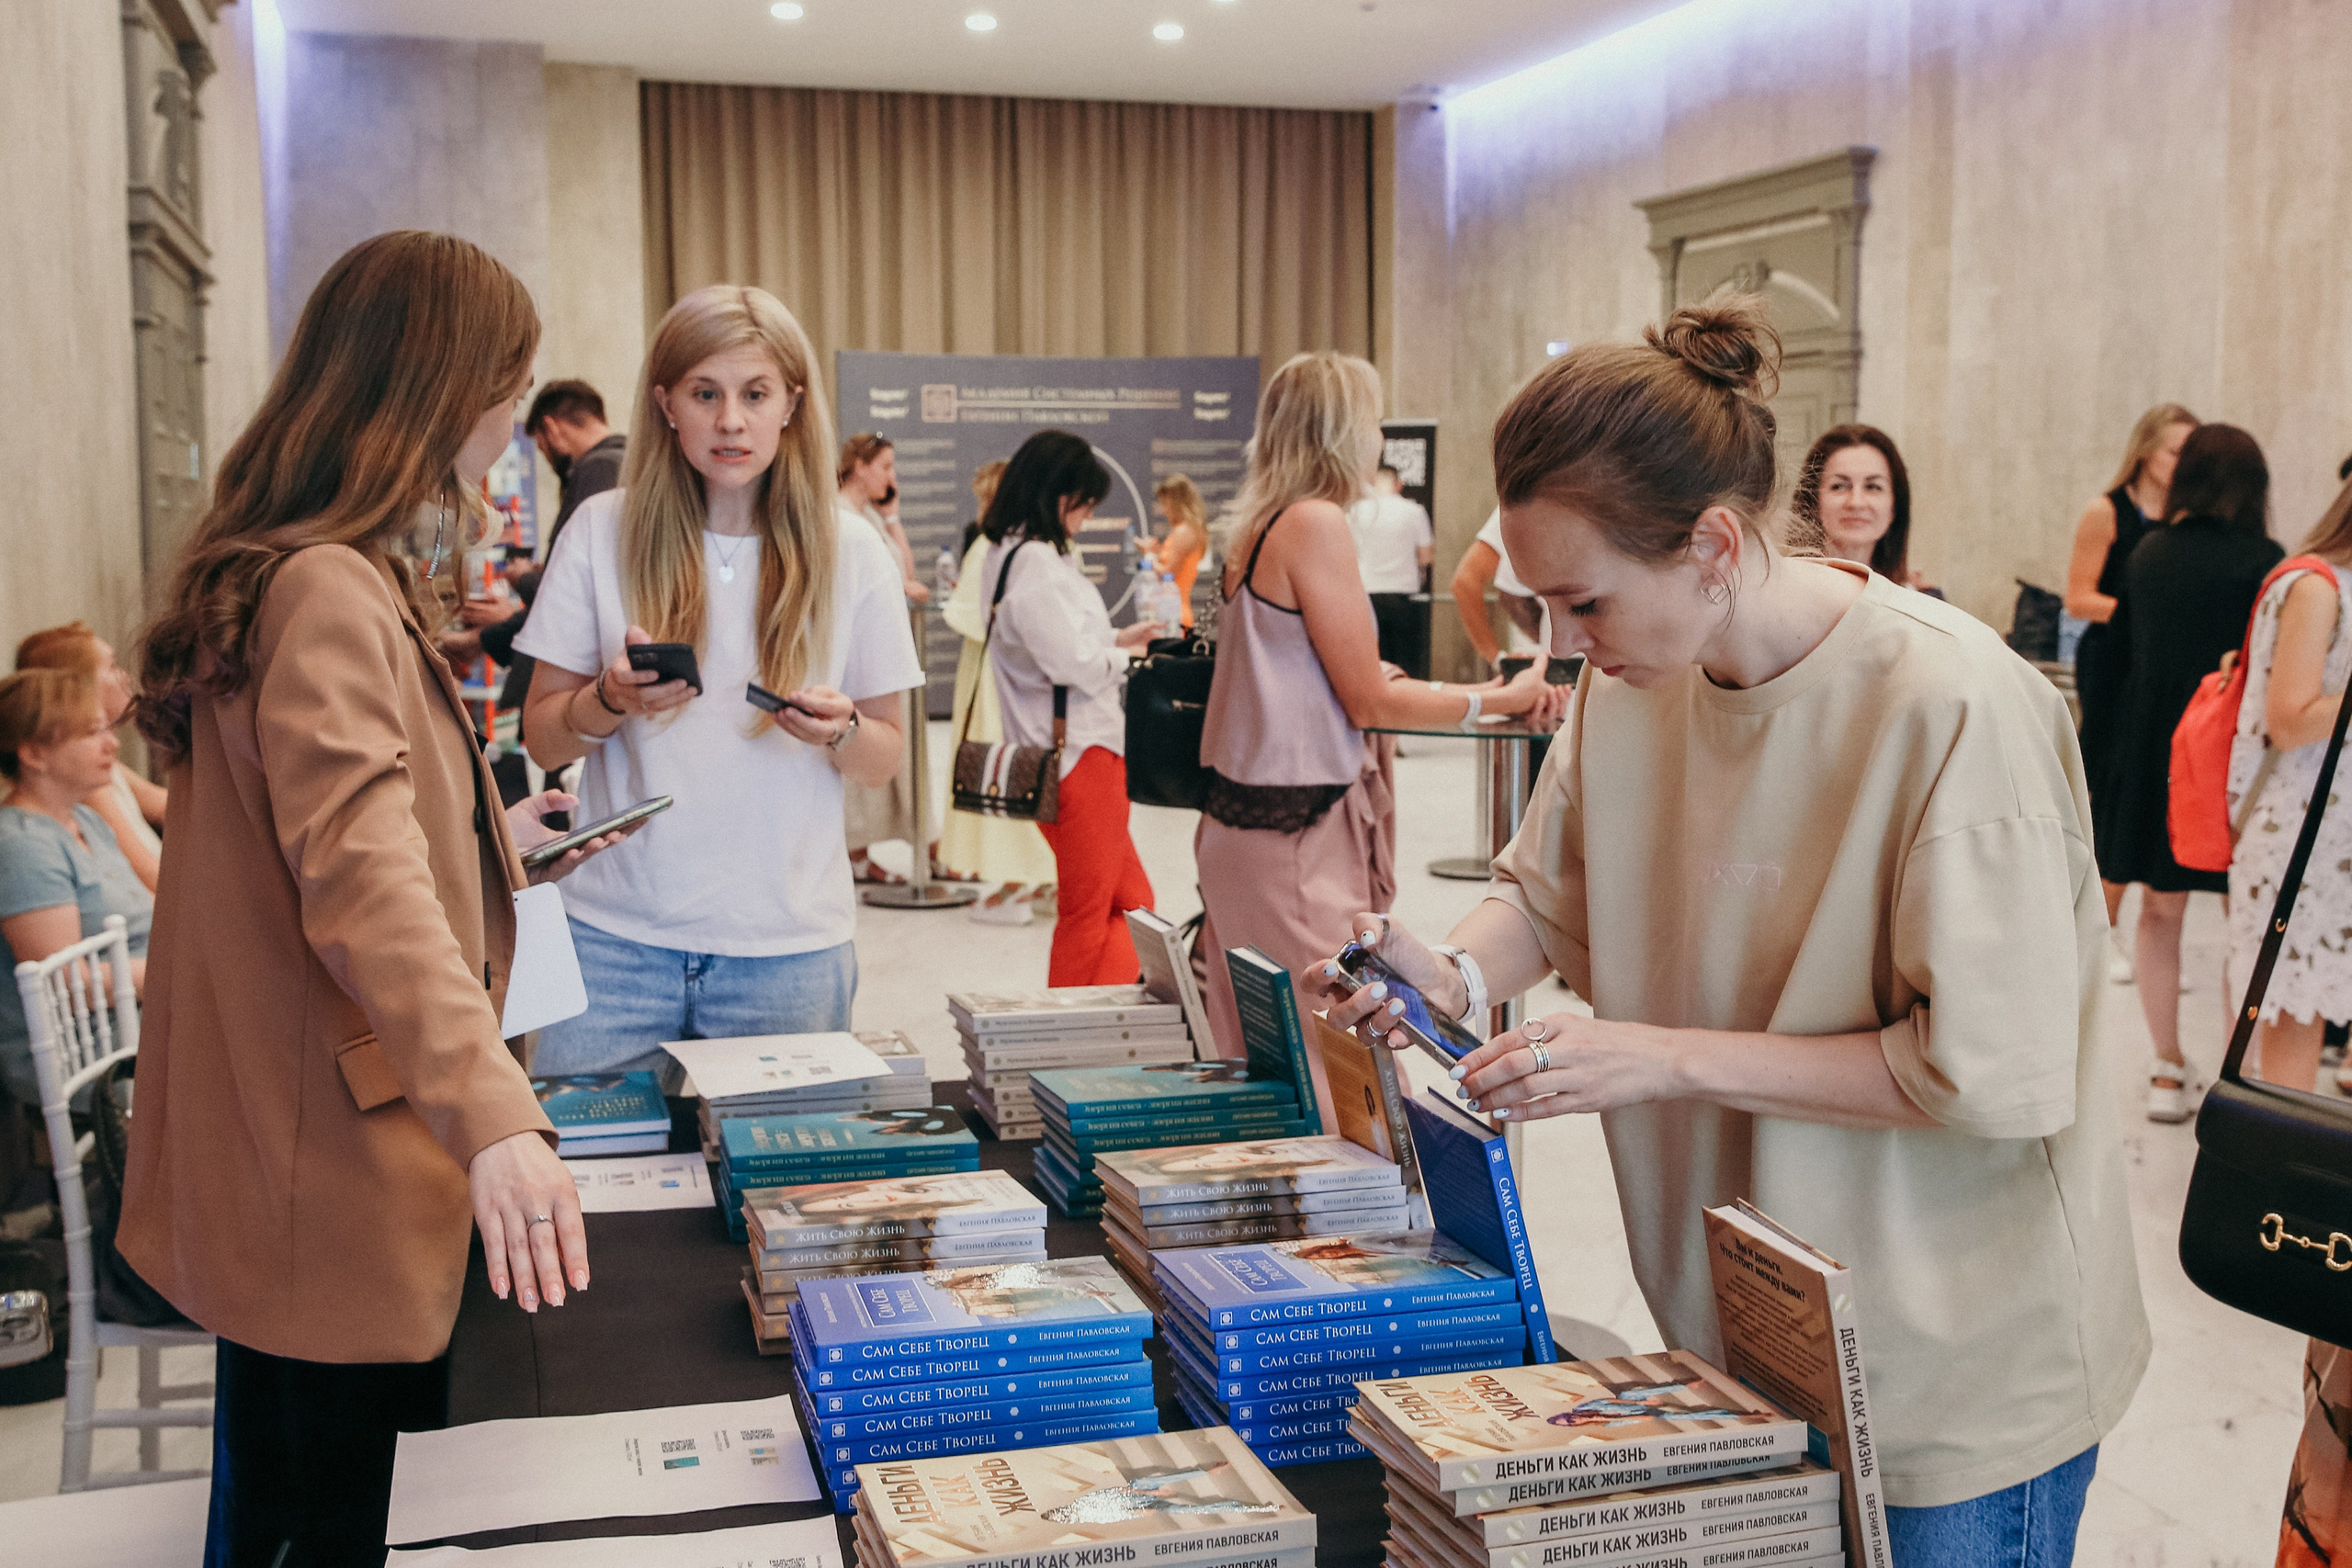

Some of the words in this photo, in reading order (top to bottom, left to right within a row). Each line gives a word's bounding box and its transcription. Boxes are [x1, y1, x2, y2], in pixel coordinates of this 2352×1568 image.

[796, 1231, 827, 1243] ЖИТЬ
[830, 1227, 864, 1240] СВОЮ
[866, 1224, 906, 1236] ЖИЗНЬ
[1499, 1178, 1512, 1207] САМ
[1507, 1209, 1521, 1239] СЕБЕ
[1515, 1240, 1532, 1290] ТВОРЕЦ
[788, 1253, 821, 1264] ЖИТЬ
[823, 1249, 858, 1262] СВОЮ
[861, 1247, 900, 1258] ЖИЗНЬ
[1411, 1294, 1444, 1304] ЕВГЕНИЯ
[1446, 1290, 1495, 1301] ПАВЛОВСКАЯ
[1250, 1308, 1280, 1321] САМ
[1283, 1304, 1314, 1318] СЕБЕ
[1317, 1301, 1367, 1314] ТВОРЕЦ
[1417, 1318, 1450, 1328] ЕВГЕНИЯ
[1452, 1314, 1500, 1325] ПАВЛОВСКАЯ
[1039, 1331, 1073, 1341] ЕВГЕНИЯ
[1077, 1325, 1130, 1337] ПАВЛОВСКАЯ
[1256, 1332, 1285, 1345] САМ
[1289, 1329, 1319, 1341] СЕБЕ
[1323, 1325, 1373, 1338] ТВОРЕЦ
[862, 1345, 894, 1358] САМ
[899, 1341, 932, 1354] СЕБЕ
[935, 1337, 989, 1351] ТВОРЕЦ
[1029, 1353, 1064, 1363] ЕВГЕНИЯ
[1067, 1348, 1119, 1359] ПАВЛОВСКАЯ
[1259, 1356, 1289, 1369] САМ
[1293, 1352, 1323, 1365] СЕБЕ
[1327, 1347, 1376, 1361] ТВОРЕЦ
[1839, 1328, 1860, 1385] ДЕНЬГИ
[853, 1369, 884, 1382] САМ
[889, 1365, 921, 1378] СЕБЕ
[926, 1359, 979, 1374] ТВОРЕЦ
[1038, 1378, 1073, 1389] ЕВГЕНИЯ
[1077, 1373, 1129, 1385] ПАВЛОВСКАЯ
[862, 1394, 894, 1407] САМ
[899, 1391, 932, 1404] СЕБЕ
[935, 1385, 989, 1400] ТВОРЕЦ
[1259, 1380, 1288, 1393] САМ
[1292, 1376, 1321, 1389] СЕБЕ
[1079, 1396, 1131, 1408] ПАВЛОВСКАЯ
[1270, 1403, 1298, 1416] САМ
[1303, 1398, 1332, 1411] СЕБЕ
[1374, 1381, 1461, 1428] ДЕНЬГИ
[1427, 1387, 1487, 1414] КАК
[1463, 1375, 1543, 1421] ЖИЗНЬ
[1850, 1389, 1865, 1420] КАК
[865, 1420, 897, 1433] САМ
[902, 1416, 933, 1429] СЕБЕ
[939, 1409, 991, 1425] ТВОРЕЦ
[1269, 1426, 1299, 1438] САМ
[1303, 1422, 1332, 1435] СЕБЕ
[869, 1444, 901, 1457] САМ
[906, 1439, 938, 1453] СЕБЕ
[943, 1434, 996, 1450] ТВОРЕЦ
[1268, 1450, 1297, 1462] САМ
[1301, 1445, 1331, 1459] СЕБЕ
[1663, 1442, 1707, 1457] ЕВГЕНИЯ
[1710, 1435, 1774, 1451] ПАВЛОВСКАЯ
[1855, 1422, 1872, 1477] ЖИЗНЬ
[1496, 1457, 1555, 1479] ДЕНЬГИ
[1558, 1453, 1589, 1470] КАК
[1593, 1448, 1646, 1466] ЖИЗНЬ
[1667, 1462, 1707, 1476] ЕВГЕНИЯ
[875, 1465, 946, 1526] ДЕНЬГИ
[929, 1472, 982, 1507] КАК
[972, 1458, 1038, 1517] ЖИЗНЬ
[1509, 1479, 1564, 1503] ДЕНЬГИ
[1569, 1475, 1597, 1492] КАК
[1601, 1470, 1652, 1487] ЖИЗНЬ
[1702, 1495, 1743, 1510] ЕВГЕНИЯ
[1746, 1486, 1808, 1504] ПАВЛОВСКАЯ
[1540, 1512, 1595, 1534] ДЕНЬГИ
[1600, 1507, 1628, 1525] КАК
[1634, 1500, 1685, 1520] ЖИЗНЬ
[1703, 1521, 1744, 1536] ЕВГЕНИЯ
[1746, 1511, 1807, 1529] ПАВЛОВСКАЯ
[1866, 1494, 1880, 1538] ЕВГЕНИЯ
[1155, 1540, 1204, 1556] ЕВГЕНИЯ
[1207, 1530, 1279, 1549] ПАВЛОВСКАЯ
[1544, 1541, 1599, 1565] ДЕНЬГИ
[1603, 1536, 1632, 1552] КАК
[1636, 1528, 1687, 1549] ЖИЗНЬ
[1703, 1551, 1745, 1566] ЕВГЕНИЯ
[1747, 1541, 1808, 1560] ПАВЛОВСКАЯ
[1036, 1552, 1069, 1568] КАК
[1075, 1545, 1136, 1566] ЖИЗНЬ
